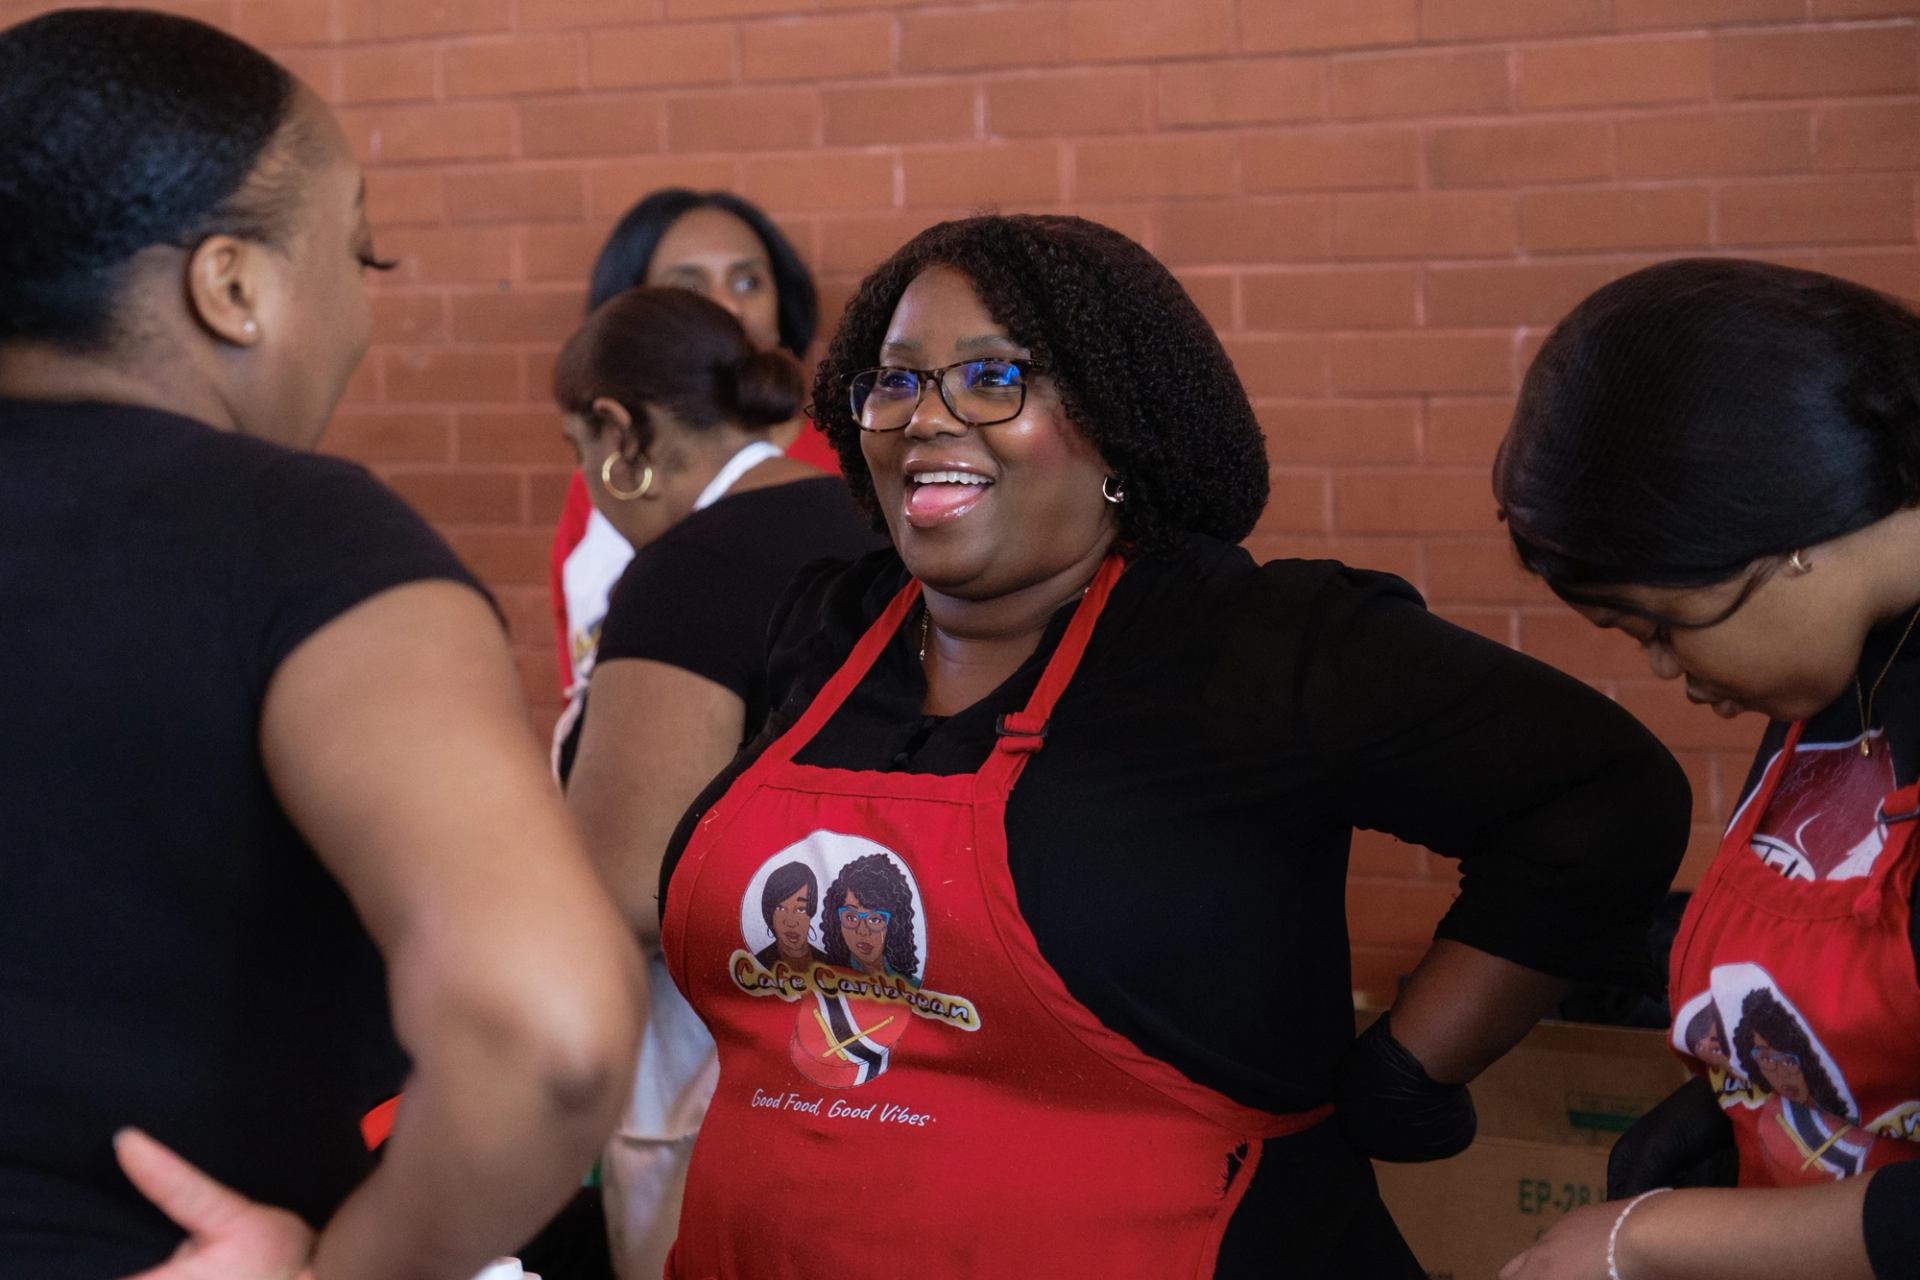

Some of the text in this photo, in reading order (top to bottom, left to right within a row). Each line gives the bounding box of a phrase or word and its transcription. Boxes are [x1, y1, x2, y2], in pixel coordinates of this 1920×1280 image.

[734, 957, 970, 1024] Cafe Caribbean
[751, 1088, 785, 1109] Good
[783, 1093, 824, 1116] Food,
[828, 1099, 877, 1120] Good
